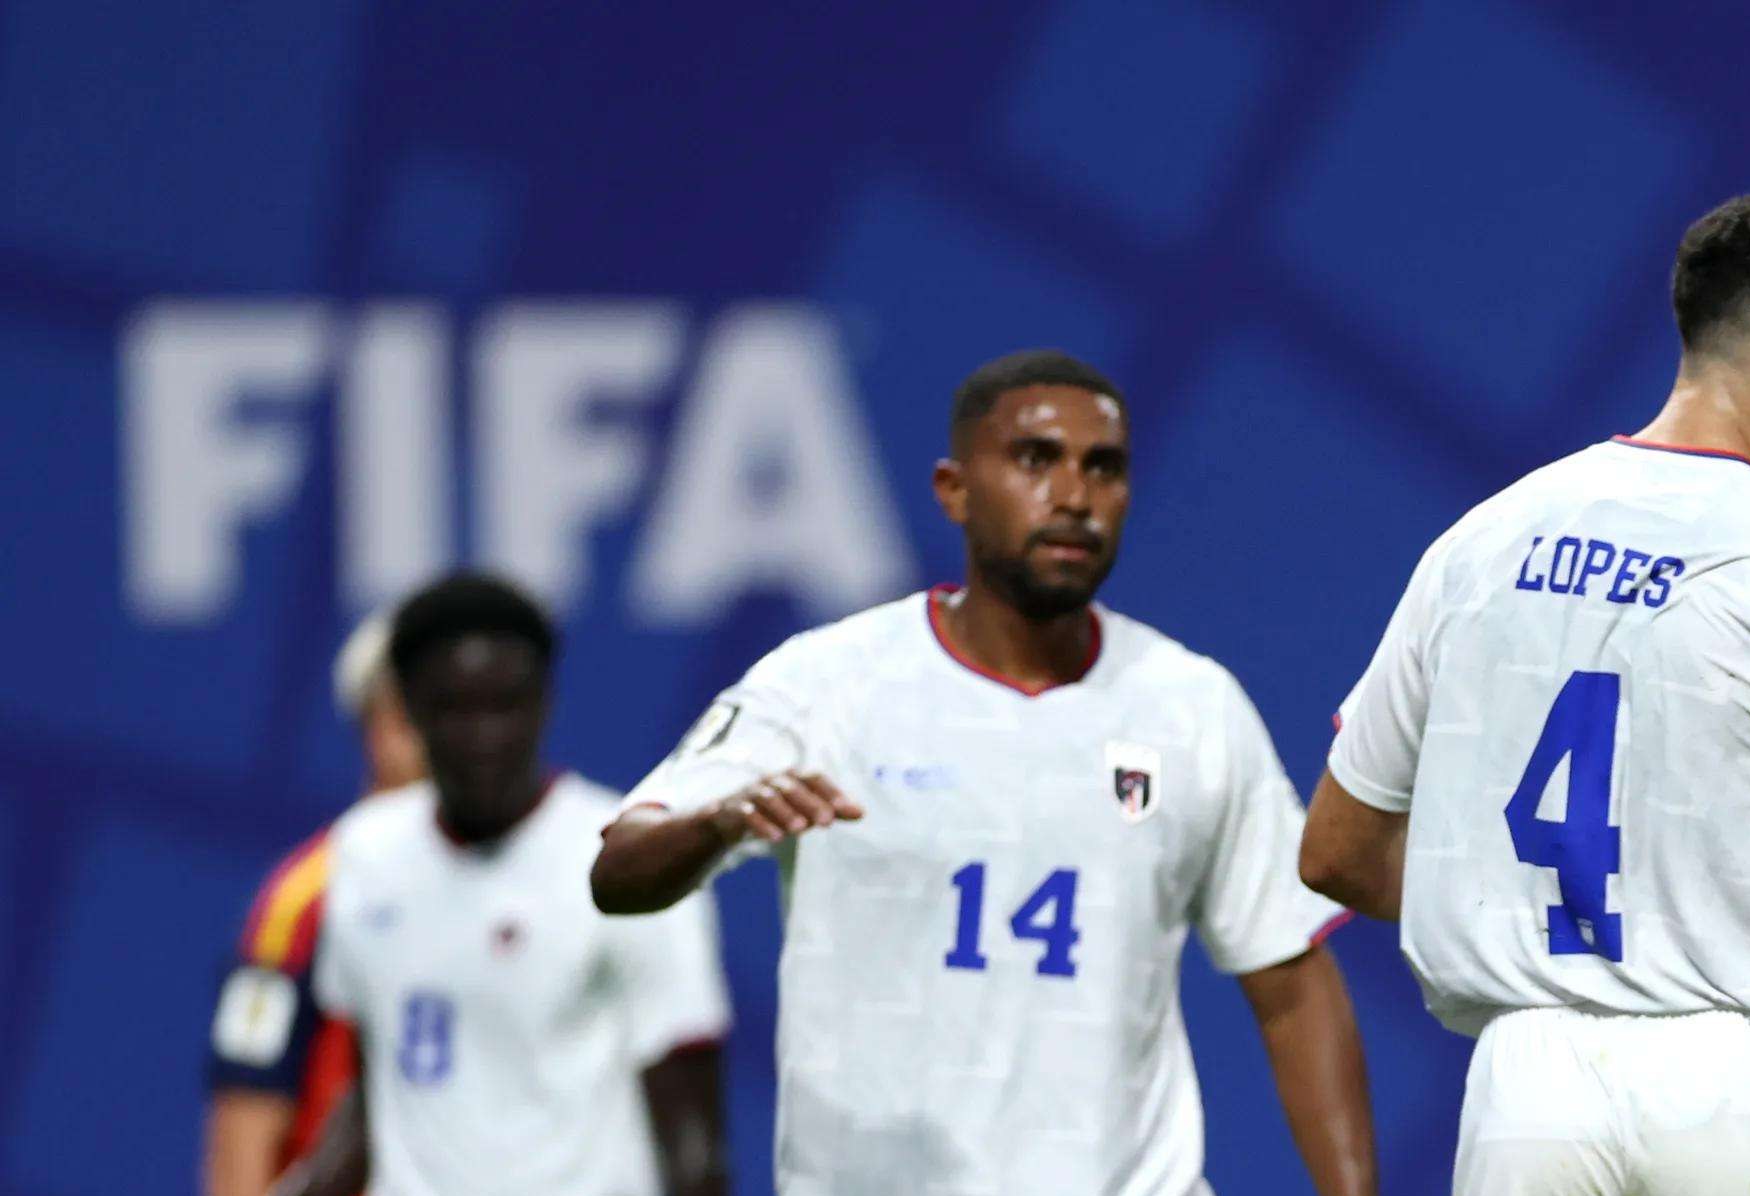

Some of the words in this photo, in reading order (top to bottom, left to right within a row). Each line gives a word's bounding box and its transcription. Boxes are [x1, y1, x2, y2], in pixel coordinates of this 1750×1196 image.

[126, 308, 906, 618] FIFA
[1515, 536, 1686, 608] LOPES
[1505, 671, 1624, 963] 4
[945, 862, 1080, 977] 14
[396, 992, 457, 1087] 8
